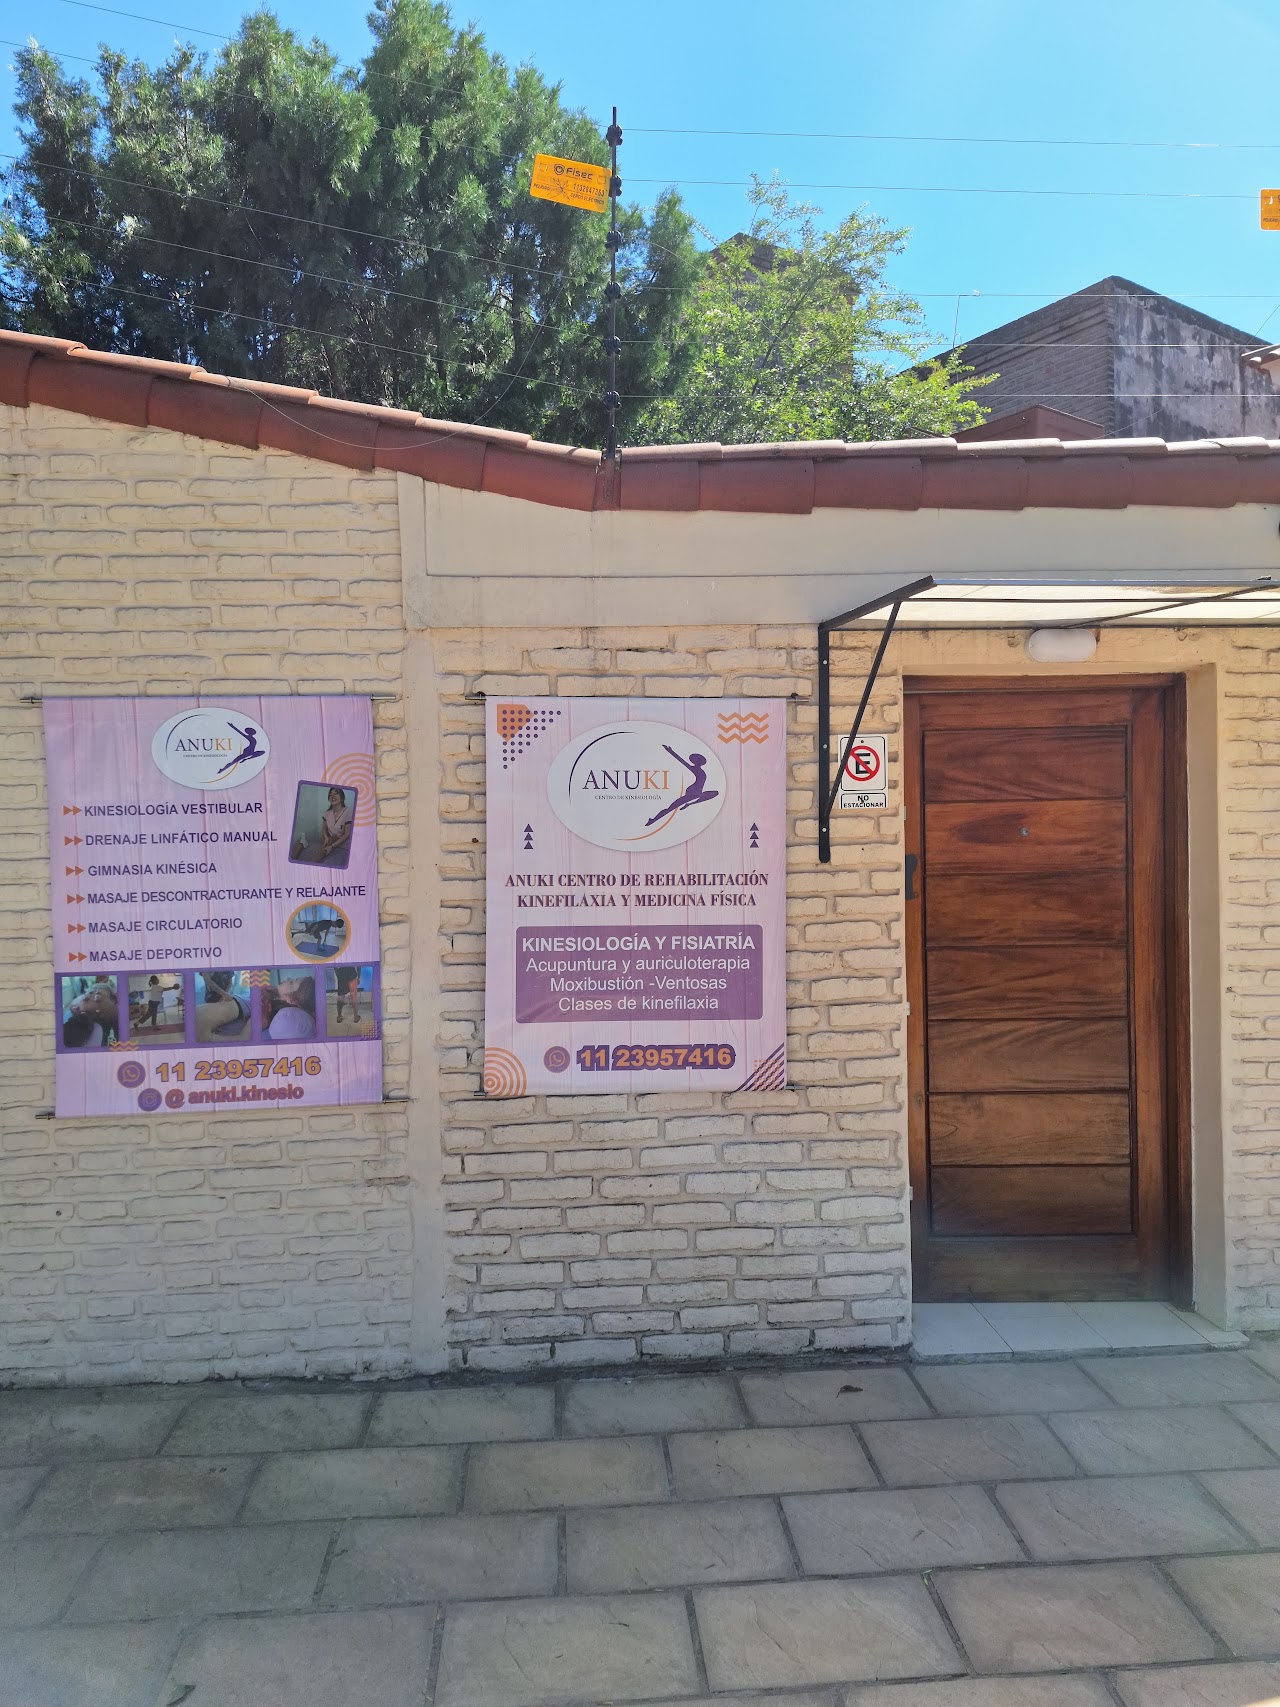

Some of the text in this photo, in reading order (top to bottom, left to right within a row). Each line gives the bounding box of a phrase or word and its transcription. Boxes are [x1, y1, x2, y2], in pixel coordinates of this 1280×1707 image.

[175, 738, 232, 751] ANUKI
[582, 770, 669, 790] ANUKI
[84, 802, 262, 816] KINESIOLOGÍA VESTIBULAR
[86, 830, 277, 846] DRENAJE LINFÁTICO MANUAL
[88, 861, 217, 877] GIMNASIA KINÉSICA
[505, 870, 768, 886] ANUKI CENTRO DE REHABILITACIÓN
[88, 886, 366, 904] MASAJE DESCONTRACTURANTE Y RELAJANTE
[621, 894, 630, 906] Y
[634, 894, 706, 906] MEDICINA
[711, 891, 756, 906] FÍSICA
[88, 918, 242, 933] MASAJE CIRCULATORIO
[522, 932, 755, 952] KINESIOLOGÍA Y FISIATRÍA
[90, 947, 222, 962] MASAJE DEPORTIVO
[526, 956, 750, 975] Acupuntura y auriculoterapia
[550, 977, 644, 992] Moxibustión
[559, 996, 718, 1012] Clases de kinefilaxia
[578, 1046, 734, 1070] 11 23957416
[156, 1056, 321, 1082] 11 23957416
